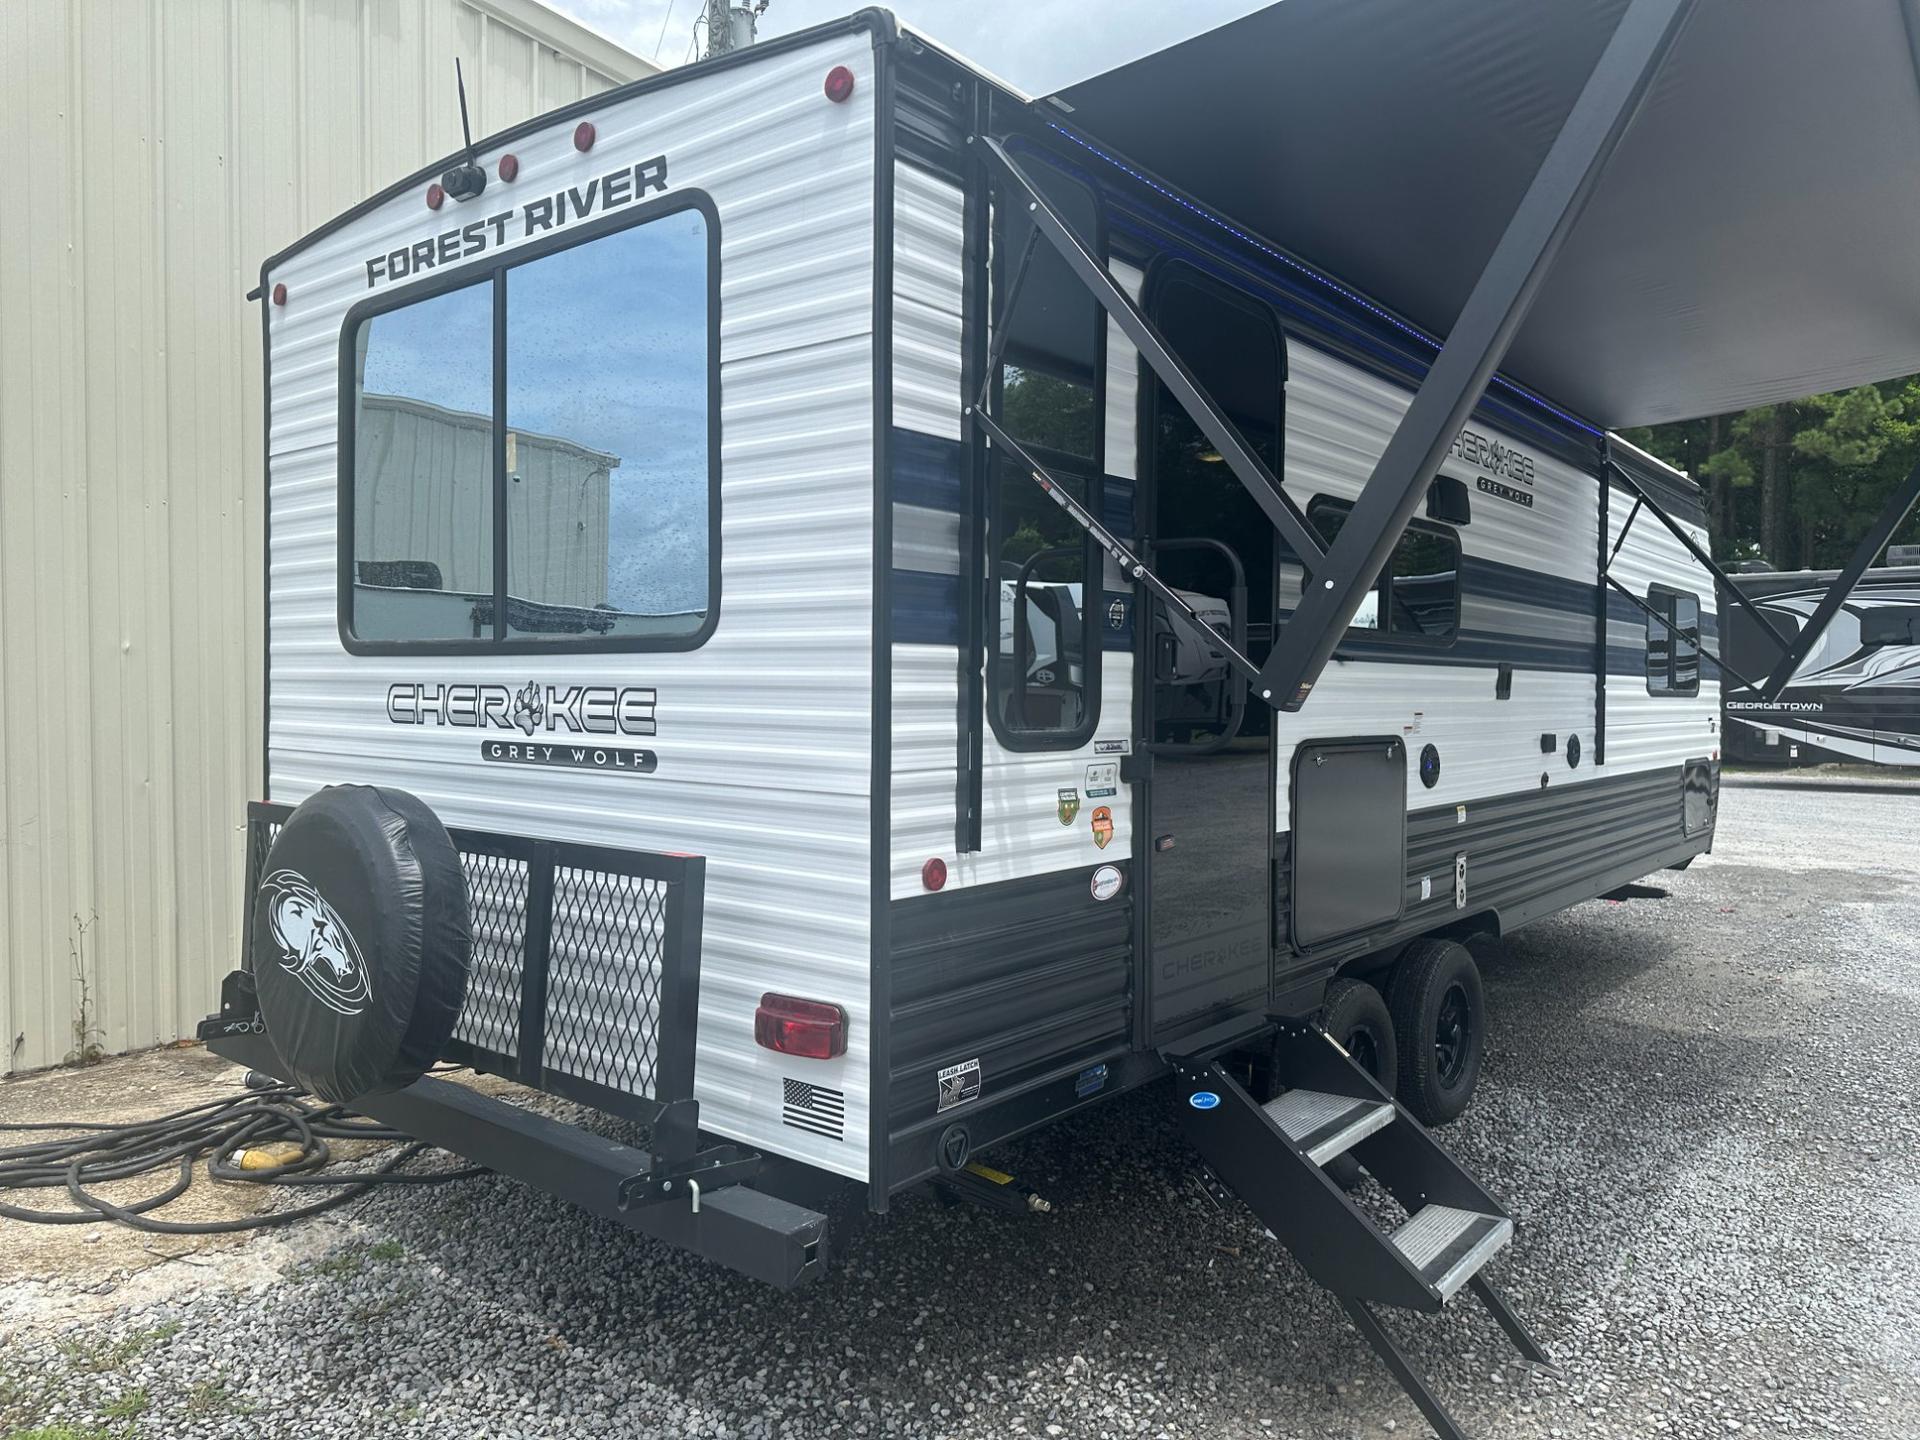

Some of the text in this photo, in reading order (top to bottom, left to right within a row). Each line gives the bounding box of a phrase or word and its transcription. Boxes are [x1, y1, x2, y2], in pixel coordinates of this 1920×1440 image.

[365, 154, 669, 289] FOREST RIVER
[1448, 430, 1535, 486] HEROKEE
[1480, 479, 1531, 503] GREY WOLF
[386, 680, 657, 737] CHEROKEE
[1726, 701, 1823, 710] GEORGETOWN
[490, 744, 644, 767] GREY WOLF
[938, 1060, 978, 1079] LEASH LATCH
